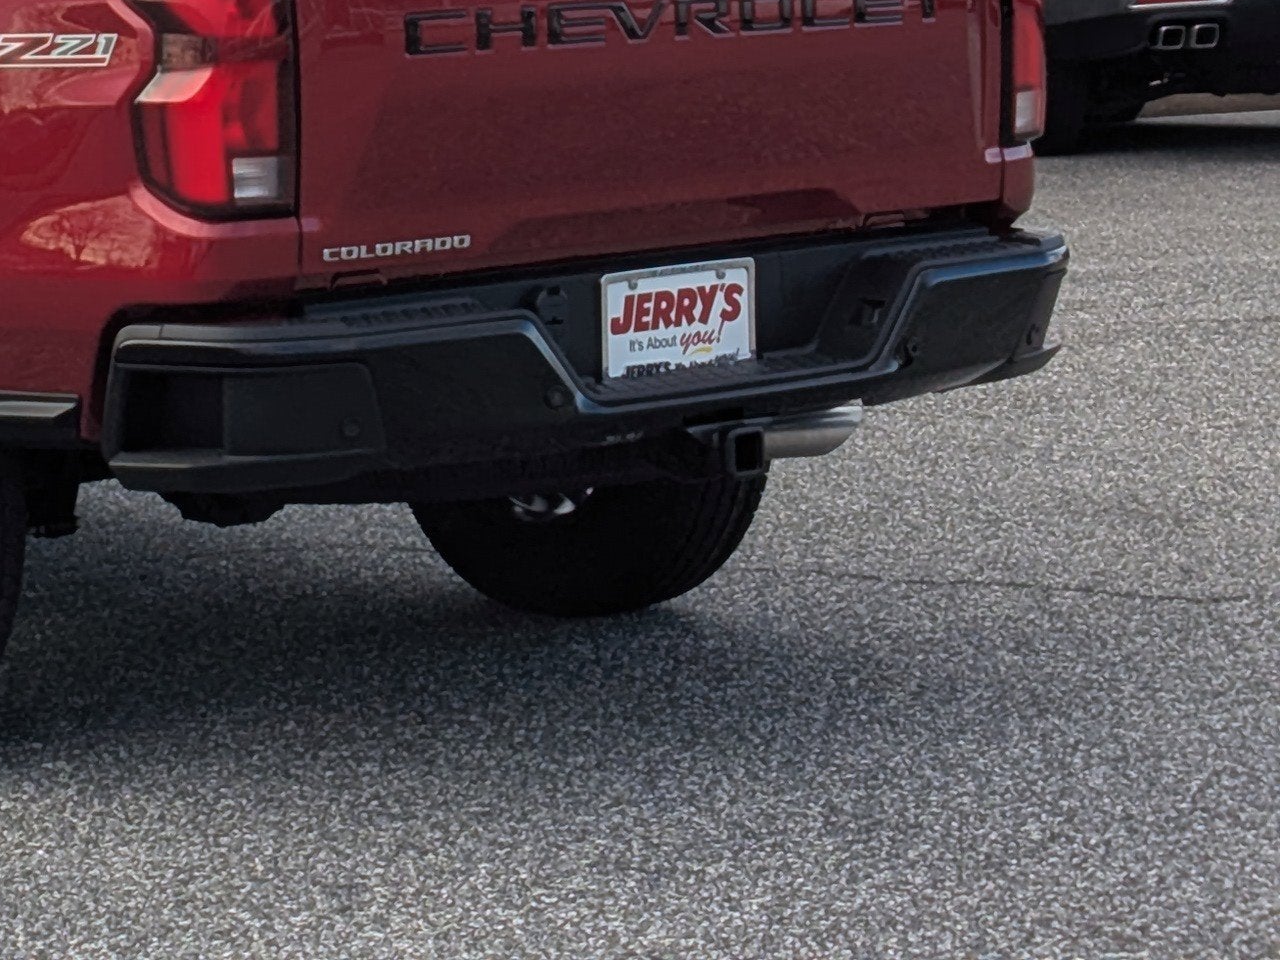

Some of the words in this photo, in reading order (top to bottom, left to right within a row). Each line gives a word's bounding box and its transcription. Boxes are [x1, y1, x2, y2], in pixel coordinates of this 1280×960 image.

[322, 234, 471, 262] COLORADO
[610, 283, 744, 336] JERRY'S
[628, 338, 645, 353] It's
[646, 334, 678, 351] About
[679, 320, 725, 356] you!
